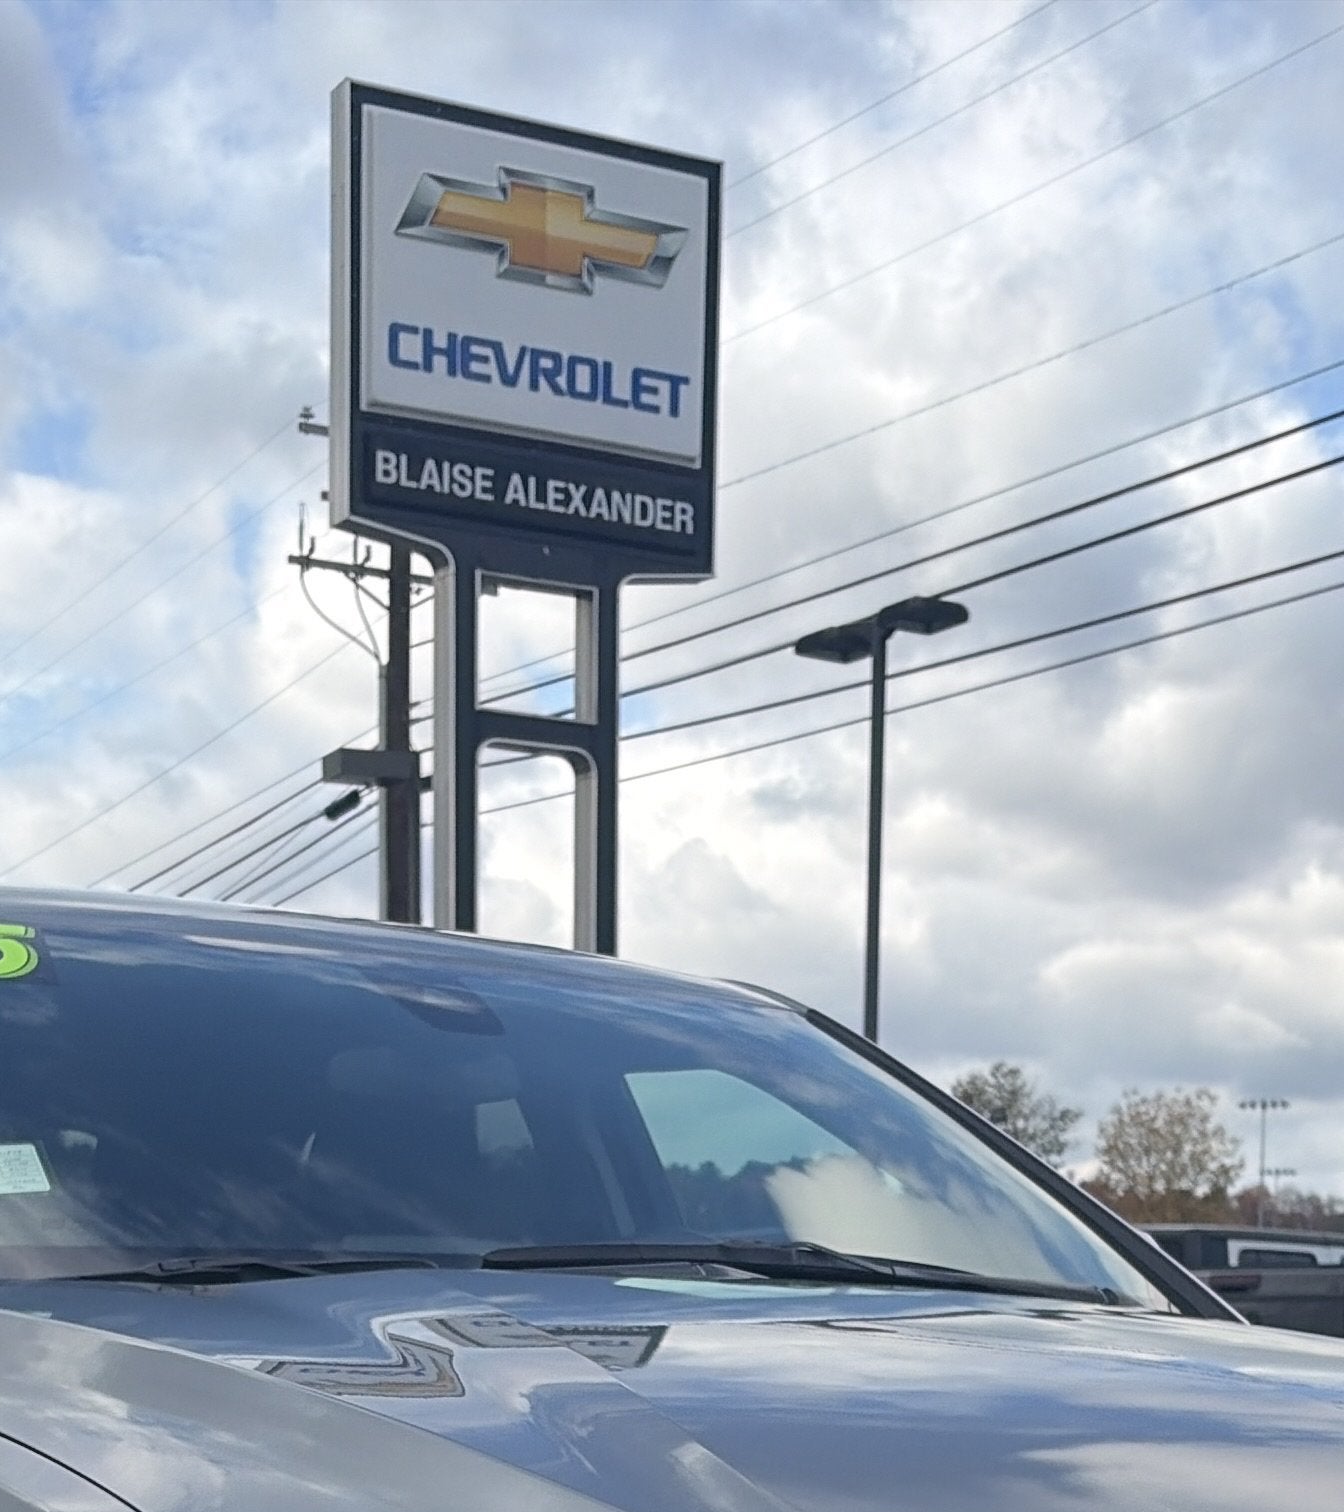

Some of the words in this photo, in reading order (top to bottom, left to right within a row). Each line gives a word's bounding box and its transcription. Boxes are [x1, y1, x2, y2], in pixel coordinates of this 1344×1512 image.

[387, 322, 690, 418] CHEVROLET
[374, 449, 495, 501] BLAISE
[504, 472, 695, 535] ALEXANDER
